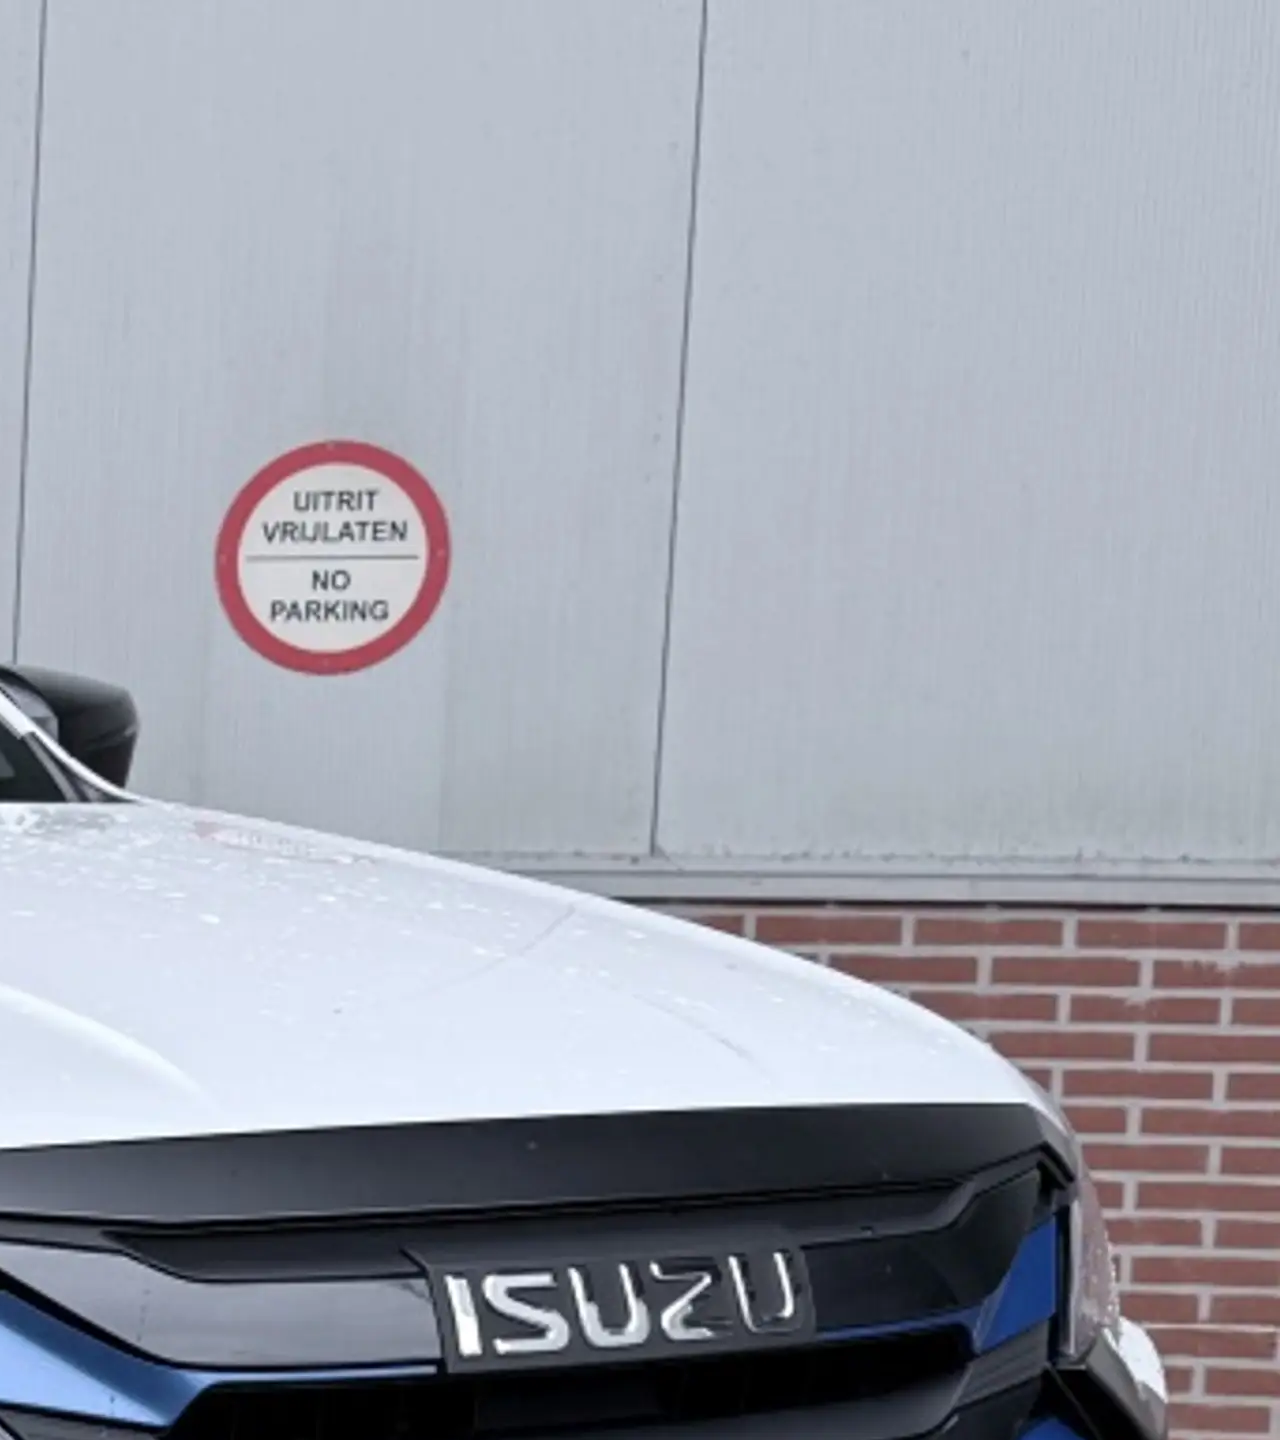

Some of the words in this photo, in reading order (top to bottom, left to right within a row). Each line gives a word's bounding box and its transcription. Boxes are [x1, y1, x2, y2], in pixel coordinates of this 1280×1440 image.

[292, 488, 380, 512] UITRIT
[262, 519, 409, 544] VRIJLATEN
[311, 568, 352, 591] NO
[269, 599, 390, 623] PARKING
[443, 1249, 803, 1358] ISUZU
